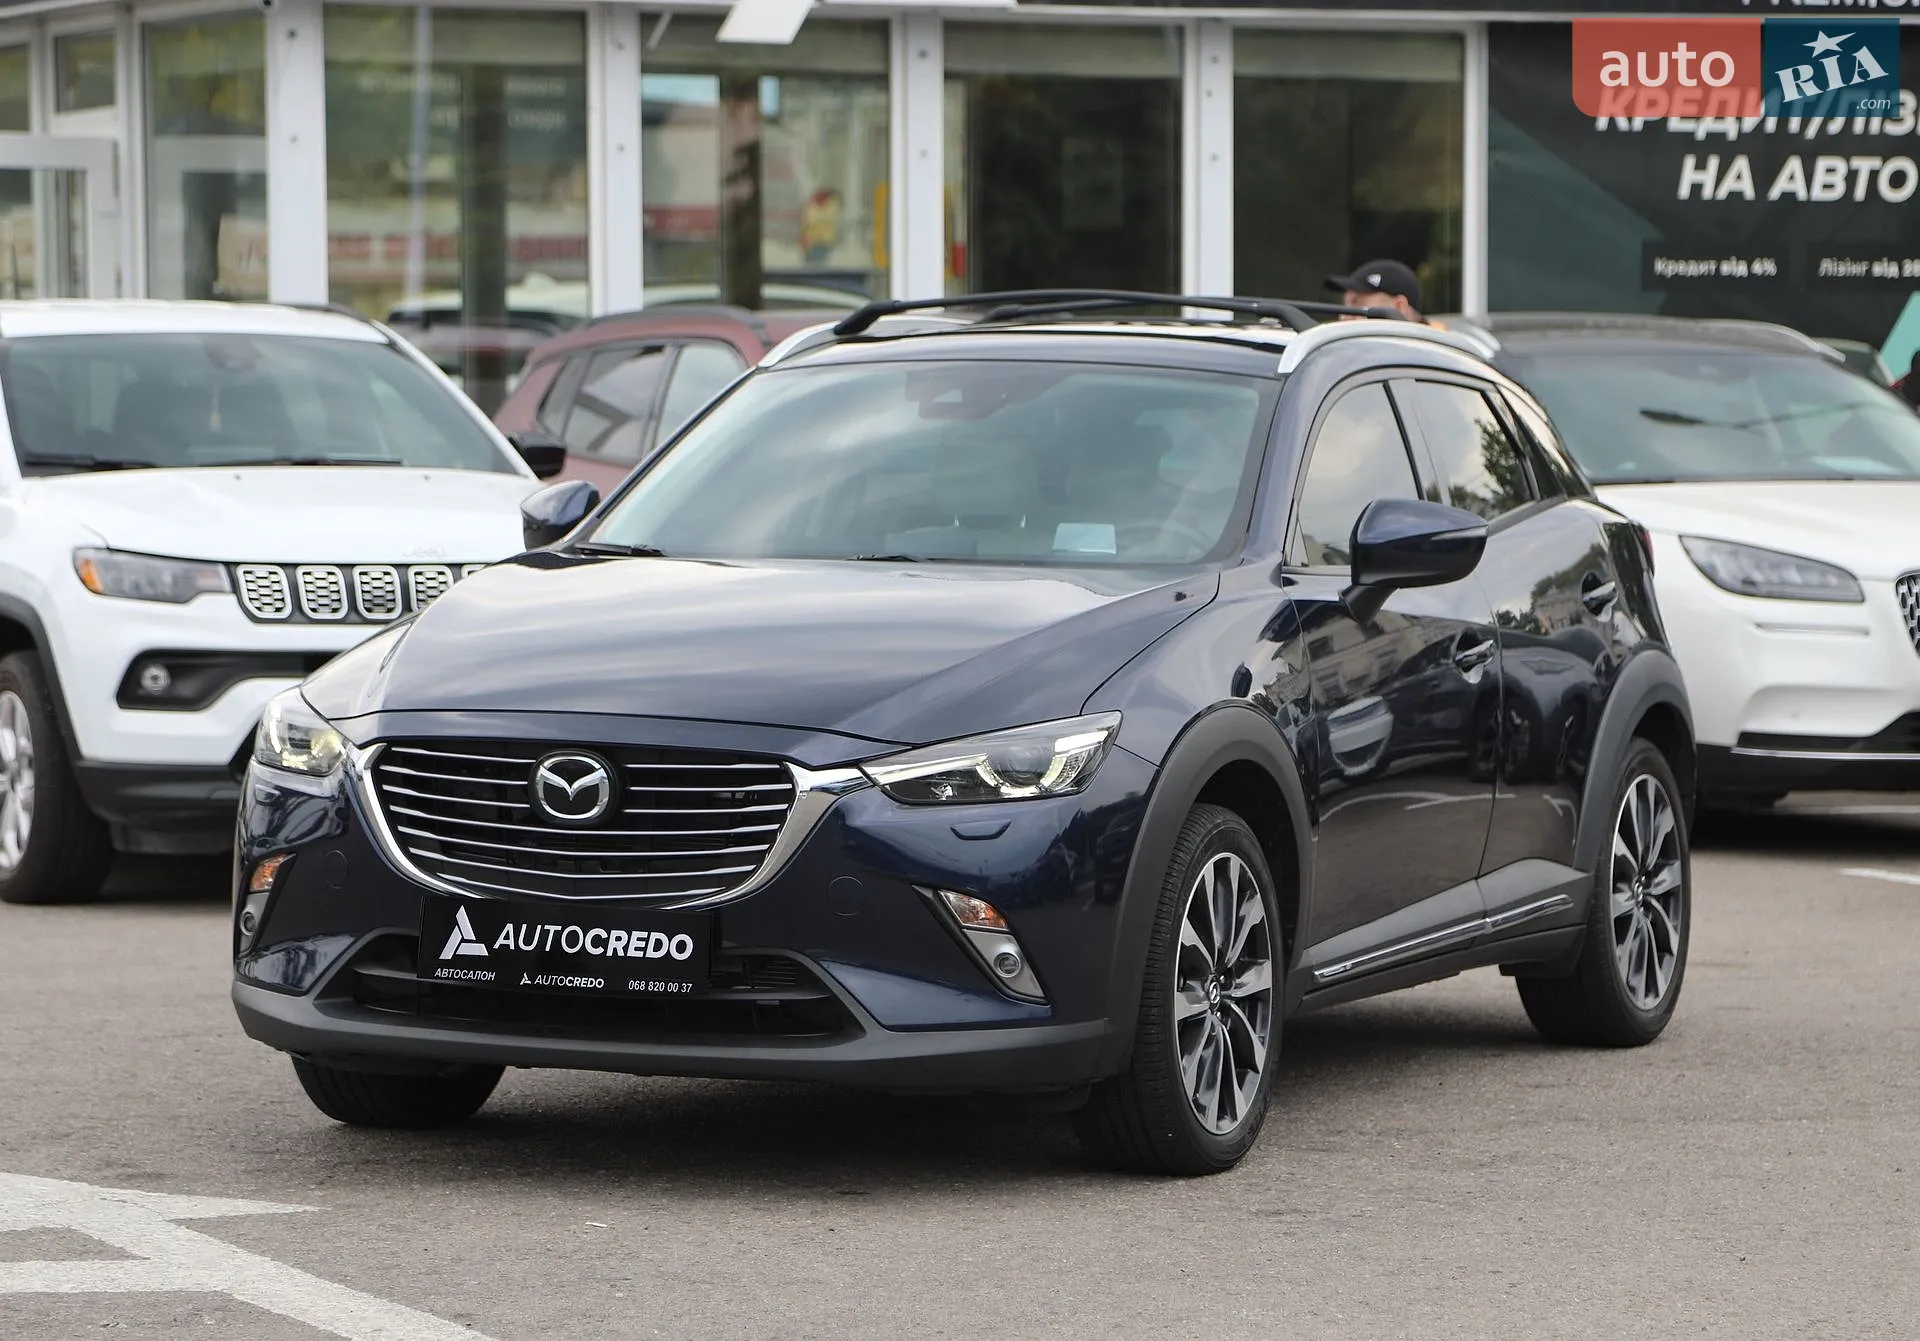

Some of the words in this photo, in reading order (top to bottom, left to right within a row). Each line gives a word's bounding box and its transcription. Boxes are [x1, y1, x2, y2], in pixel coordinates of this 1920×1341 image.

[1677, 154, 1756, 201] НА
[1766, 155, 1919, 203] АВТО
[493, 923, 693, 960] AUTOCREDO
[434, 967, 496, 981] АВТОСАЛОН
[534, 974, 604, 989] AUTOCREDO
[628, 979, 646, 991] 068
[647, 981, 665, 992] 820
[667, 982, 679, 992] 00
[680, 983, 692, 993] 37
